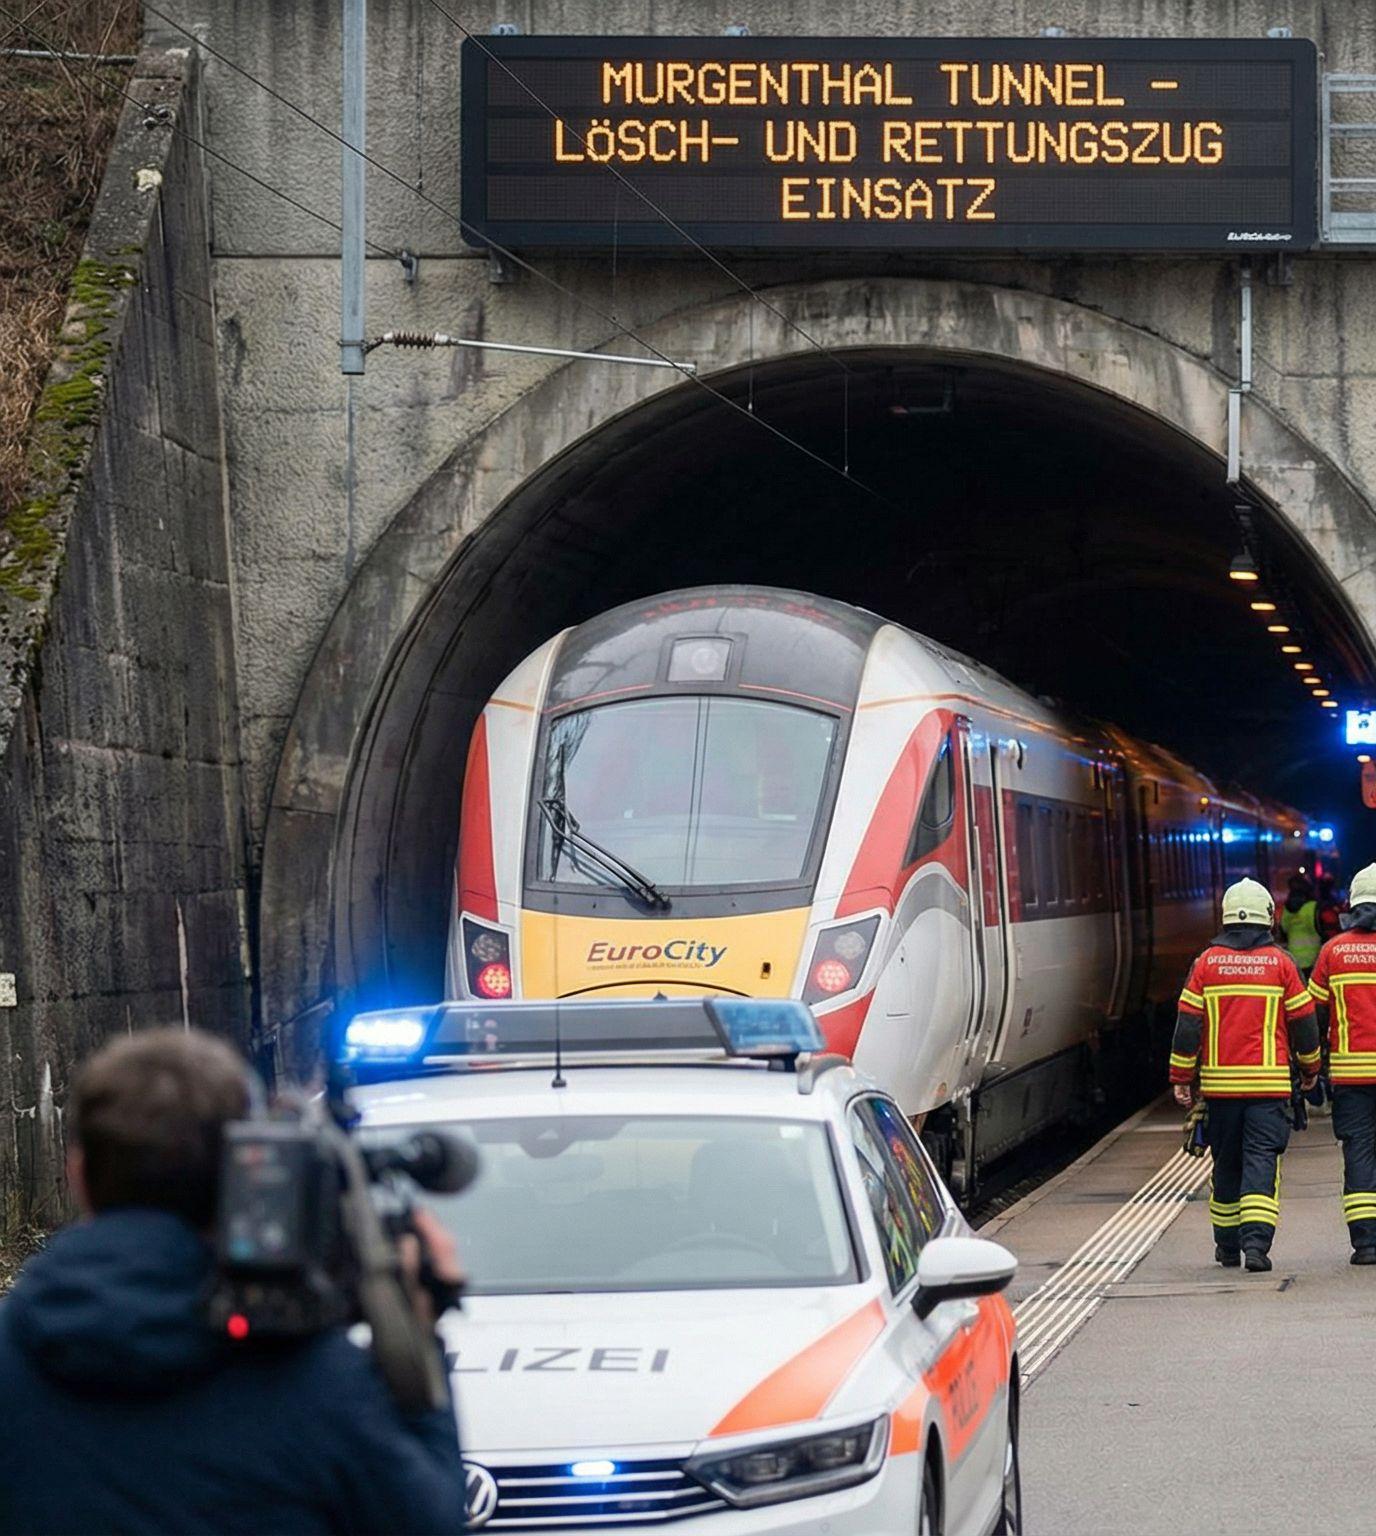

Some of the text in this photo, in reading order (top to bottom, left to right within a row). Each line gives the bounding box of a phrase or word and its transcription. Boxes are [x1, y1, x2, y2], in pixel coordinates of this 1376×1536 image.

[603, 62, 913, 106] MURGENTHAL
[940, 63, 1125, 106] TUNNEL
[555, 118, 1223, 164] LÖSCH- UND RETTUNGSZUG
[782, 177, 996, 220] EINSATZ
[586, 940, 728, 968] EuroCity
[446, 1346, 670, 1374] LIZEI
